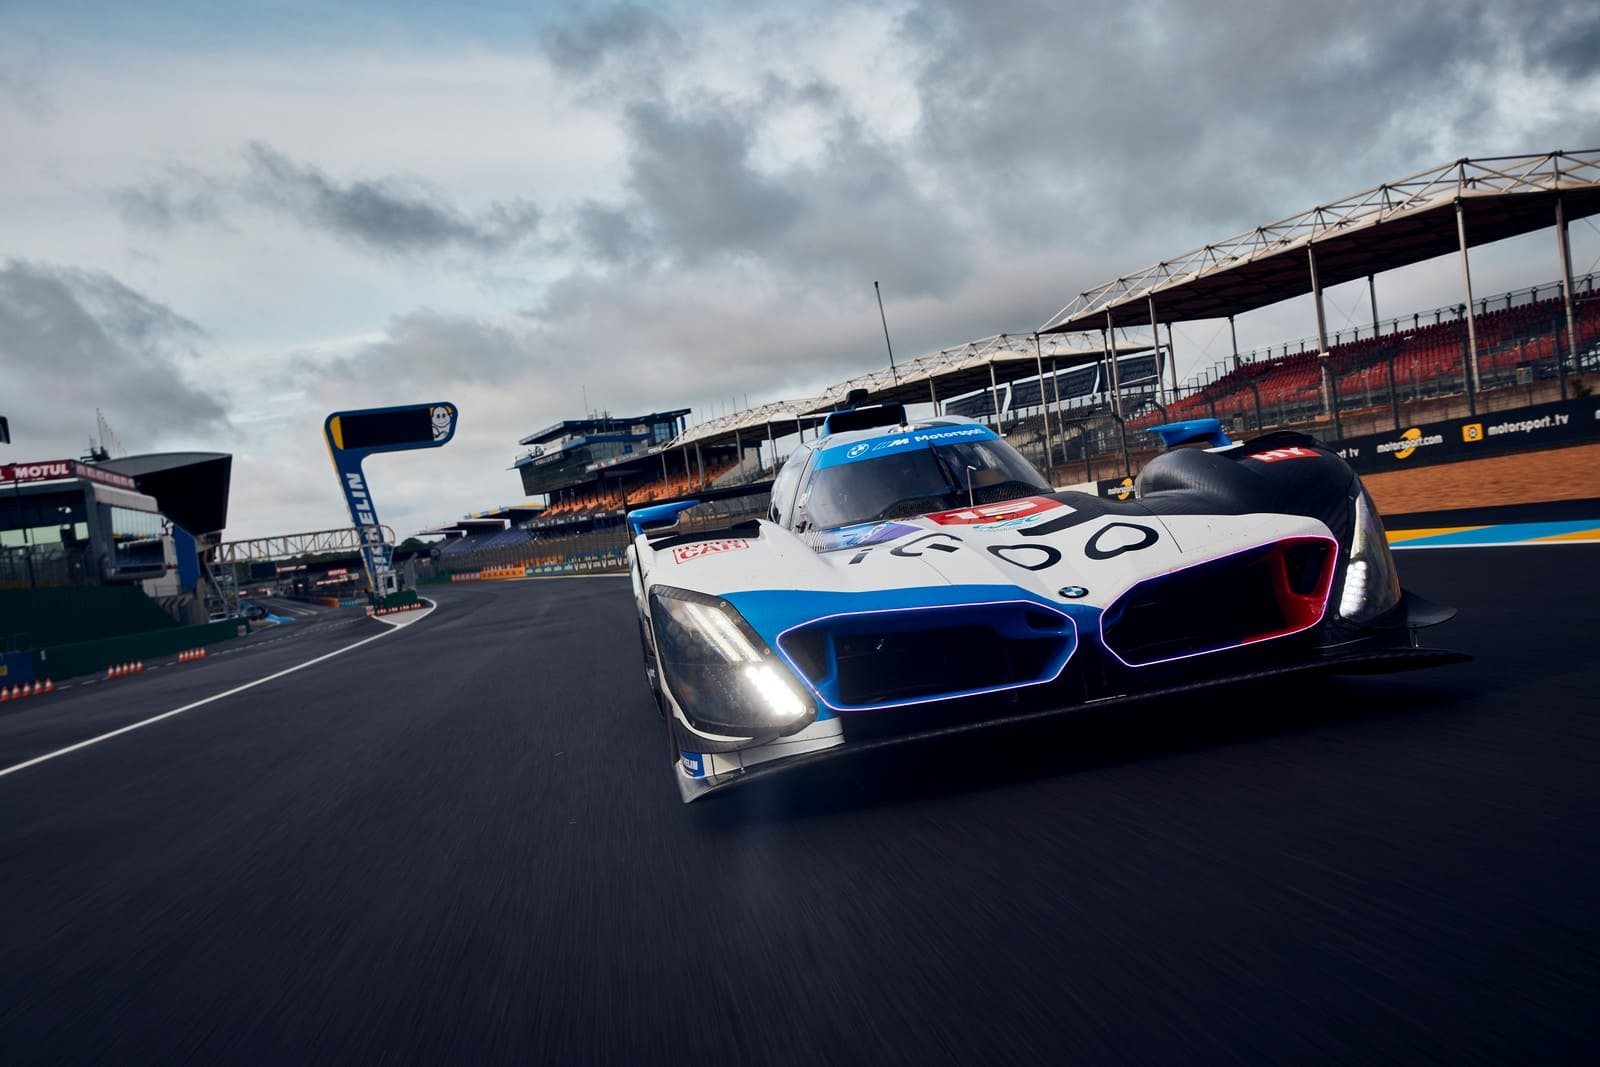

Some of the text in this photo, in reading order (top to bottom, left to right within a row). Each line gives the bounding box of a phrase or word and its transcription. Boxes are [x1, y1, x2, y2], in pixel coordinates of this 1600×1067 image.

[1487, 414, 1569, 433] motorsport.tv
[914, 428, 985, 442] Motorsport
[1376, 434, 1443, 453] motorsport.com
[14, 463, 69, 479] MOTUL
[679, 543, 742, 559] CAR
